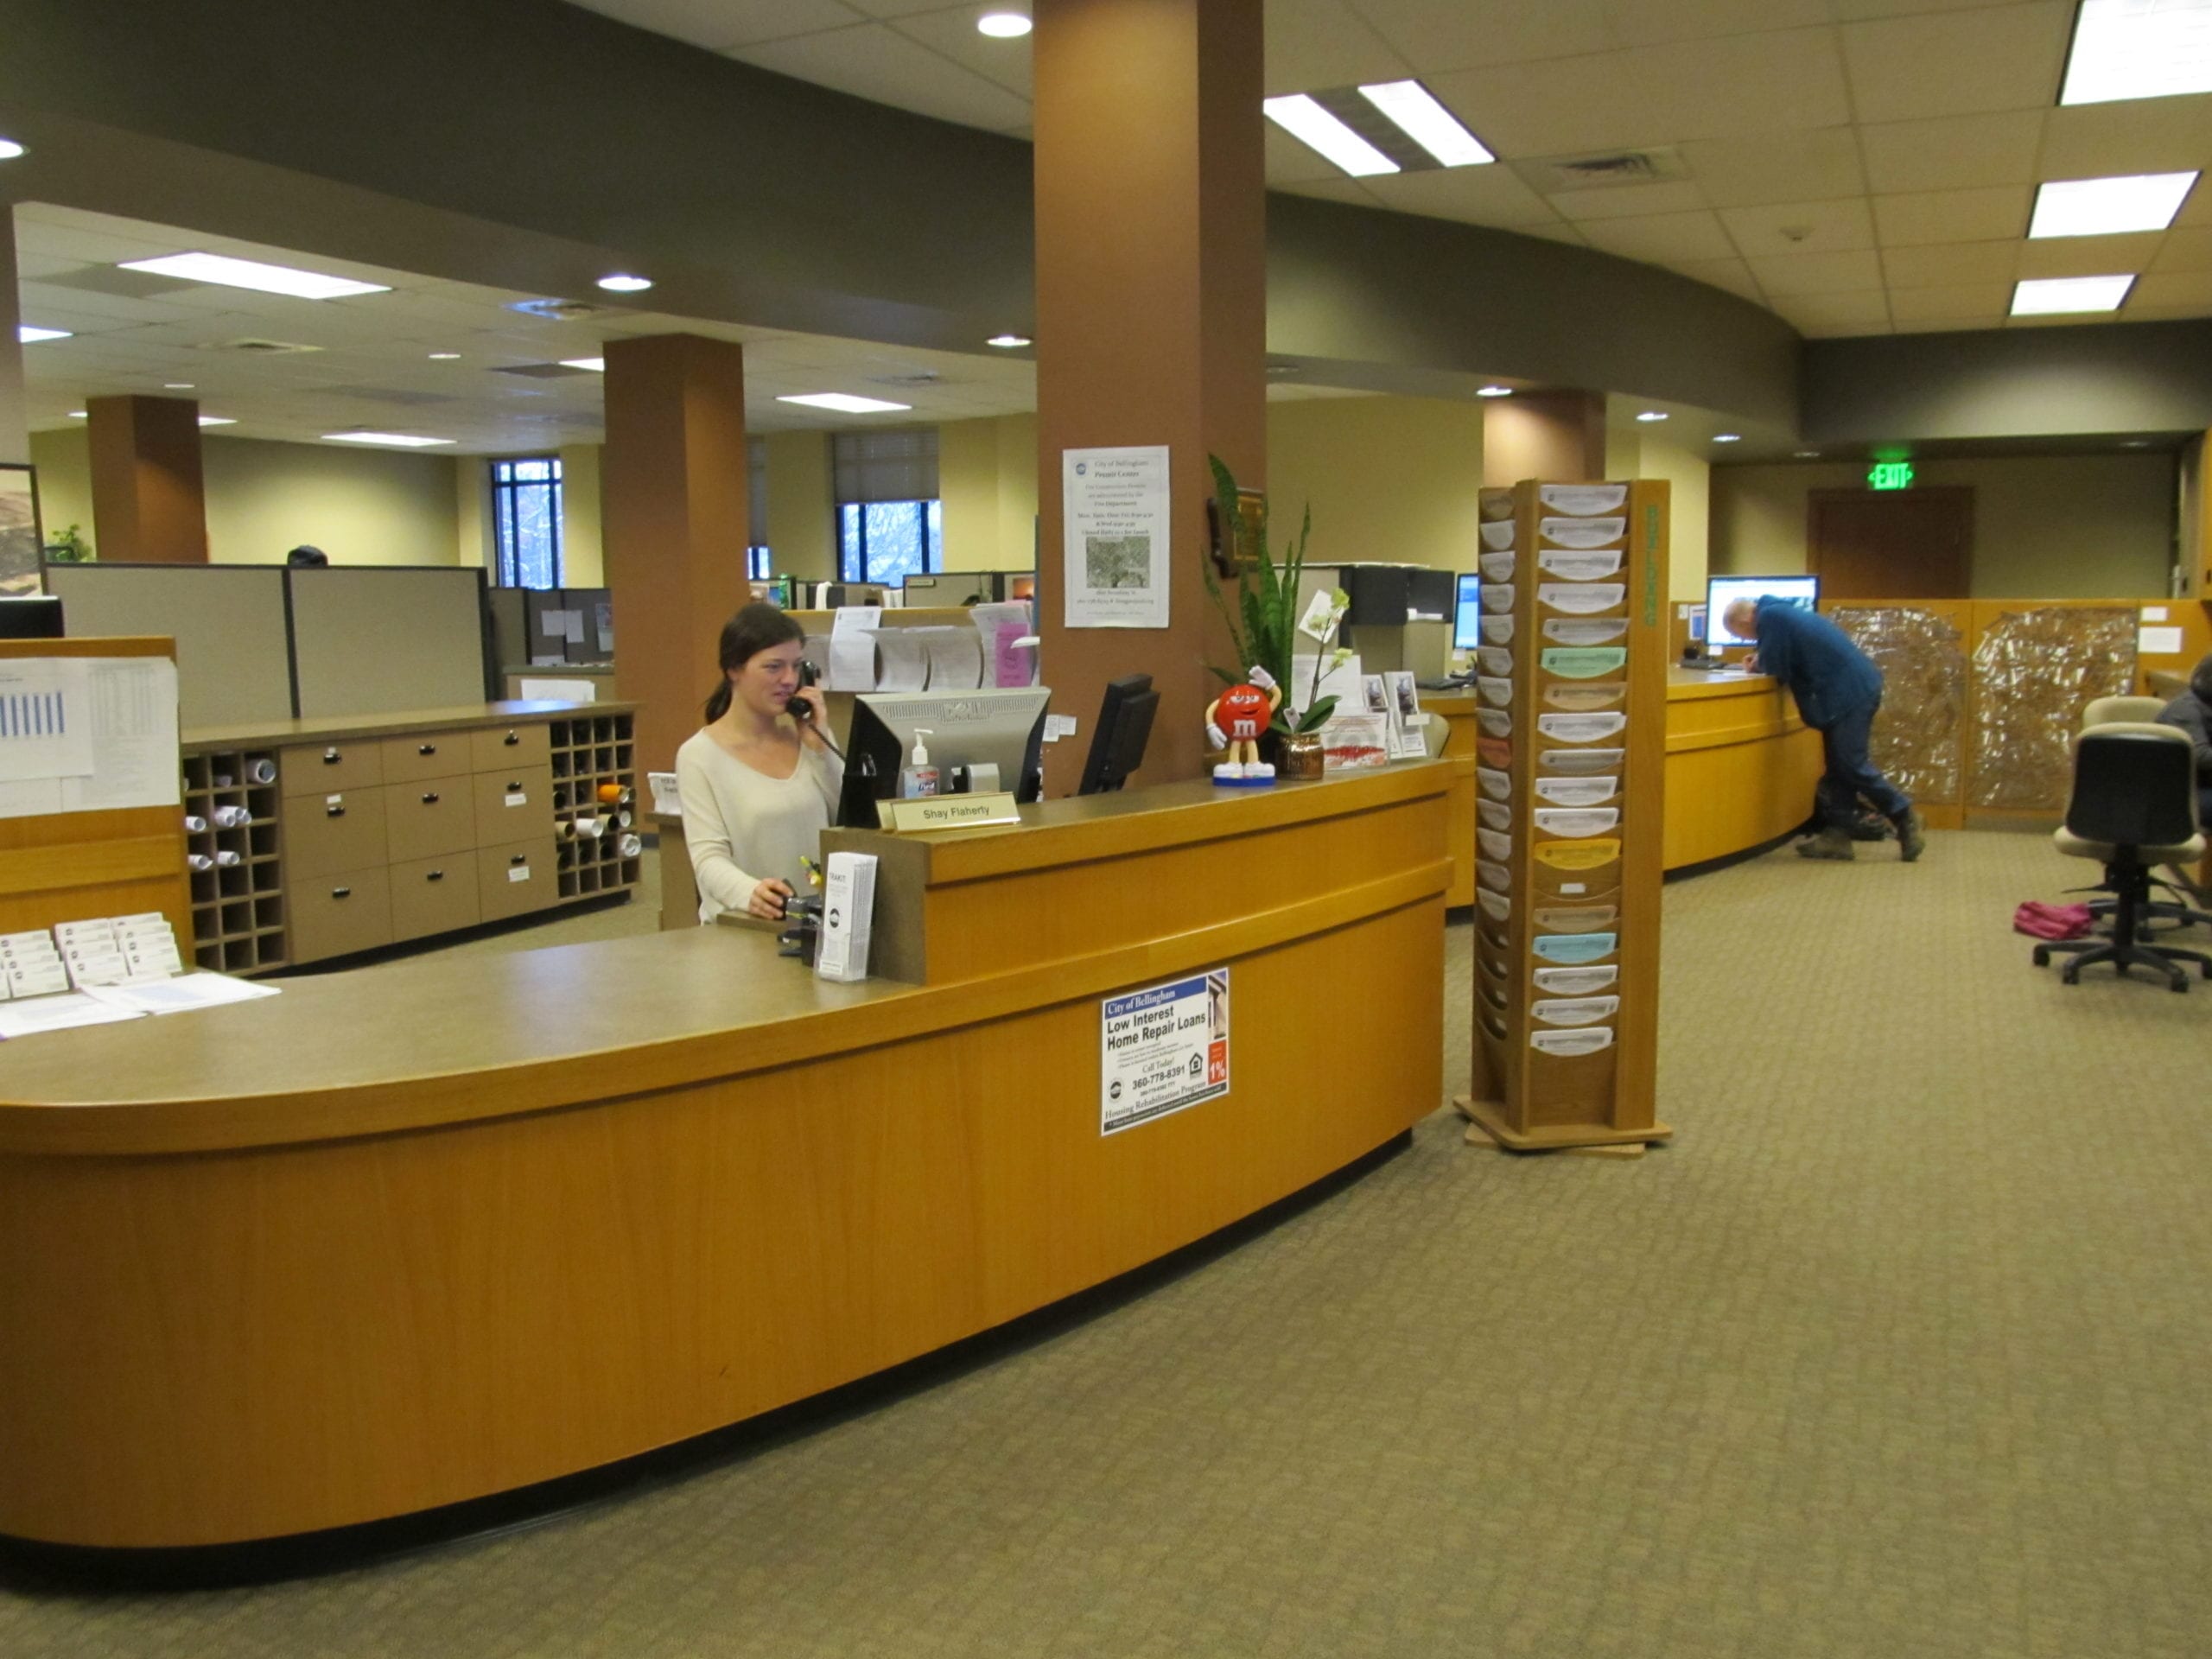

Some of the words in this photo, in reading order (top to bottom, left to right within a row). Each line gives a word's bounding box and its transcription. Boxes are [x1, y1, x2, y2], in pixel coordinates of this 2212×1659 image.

[1875, 463, 1908, 490] EXIT
[923, 808, 948, 820] Shay
[950, 805, 990, 817] Flaherty
[1108, 1001, 1123, 1015] City
[1125, 998, 1134, 1010] of
[1135, 989, 1175, 1008] Bellingham
[1107, 1019, 1130, 1034] Low
[1134, 1005, 1174, 1027] Interest
[1108, 1033, 1139, 1052] Home
[1142, 1021, 1175, 1041] Repair
[1178, 1013, 1206, 1031] Loans
[1132, 1066, 1185, 1090] 360-778-8391
[1142, 1061, 1154, 1073] Call
[1210, 1060, 1225, 1080] 1%
[1105, 1103, 1134, 1120] Housing
[1135, 1087, 1180, 1110] Rehabilitation
[1180, 1081, 1206, 1098] Program
